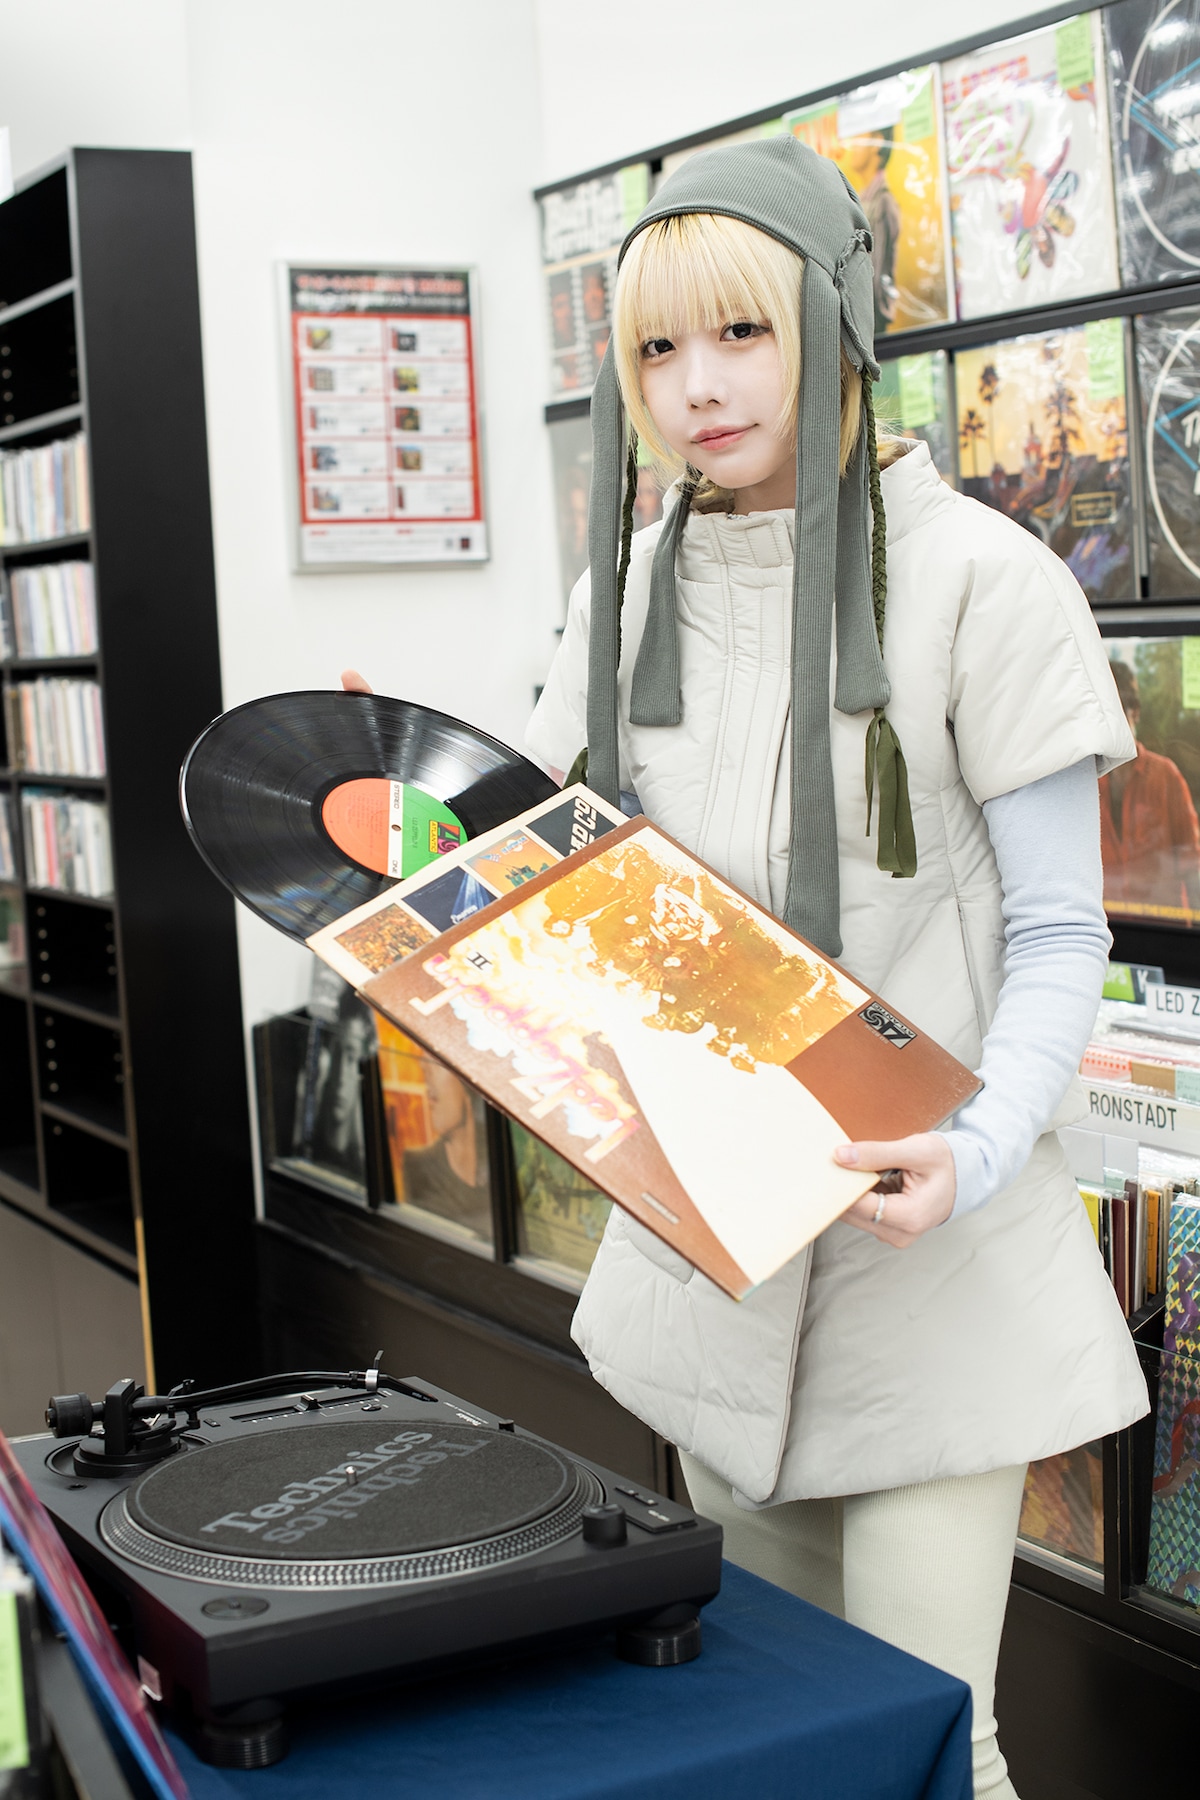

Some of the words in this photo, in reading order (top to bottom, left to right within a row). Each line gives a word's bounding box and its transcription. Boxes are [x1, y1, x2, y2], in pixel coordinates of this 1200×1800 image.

[467, 951, 492, 971] II
[871, 1003, 915, 1037] ATLANTIC
[1155, 989, 1185, 1014] LED
[1089, 1091, 1177, 1132] RONSTADT
[200, 1431, 433, 1535] Technics
[262, 1438, 491, 1545] Technics
